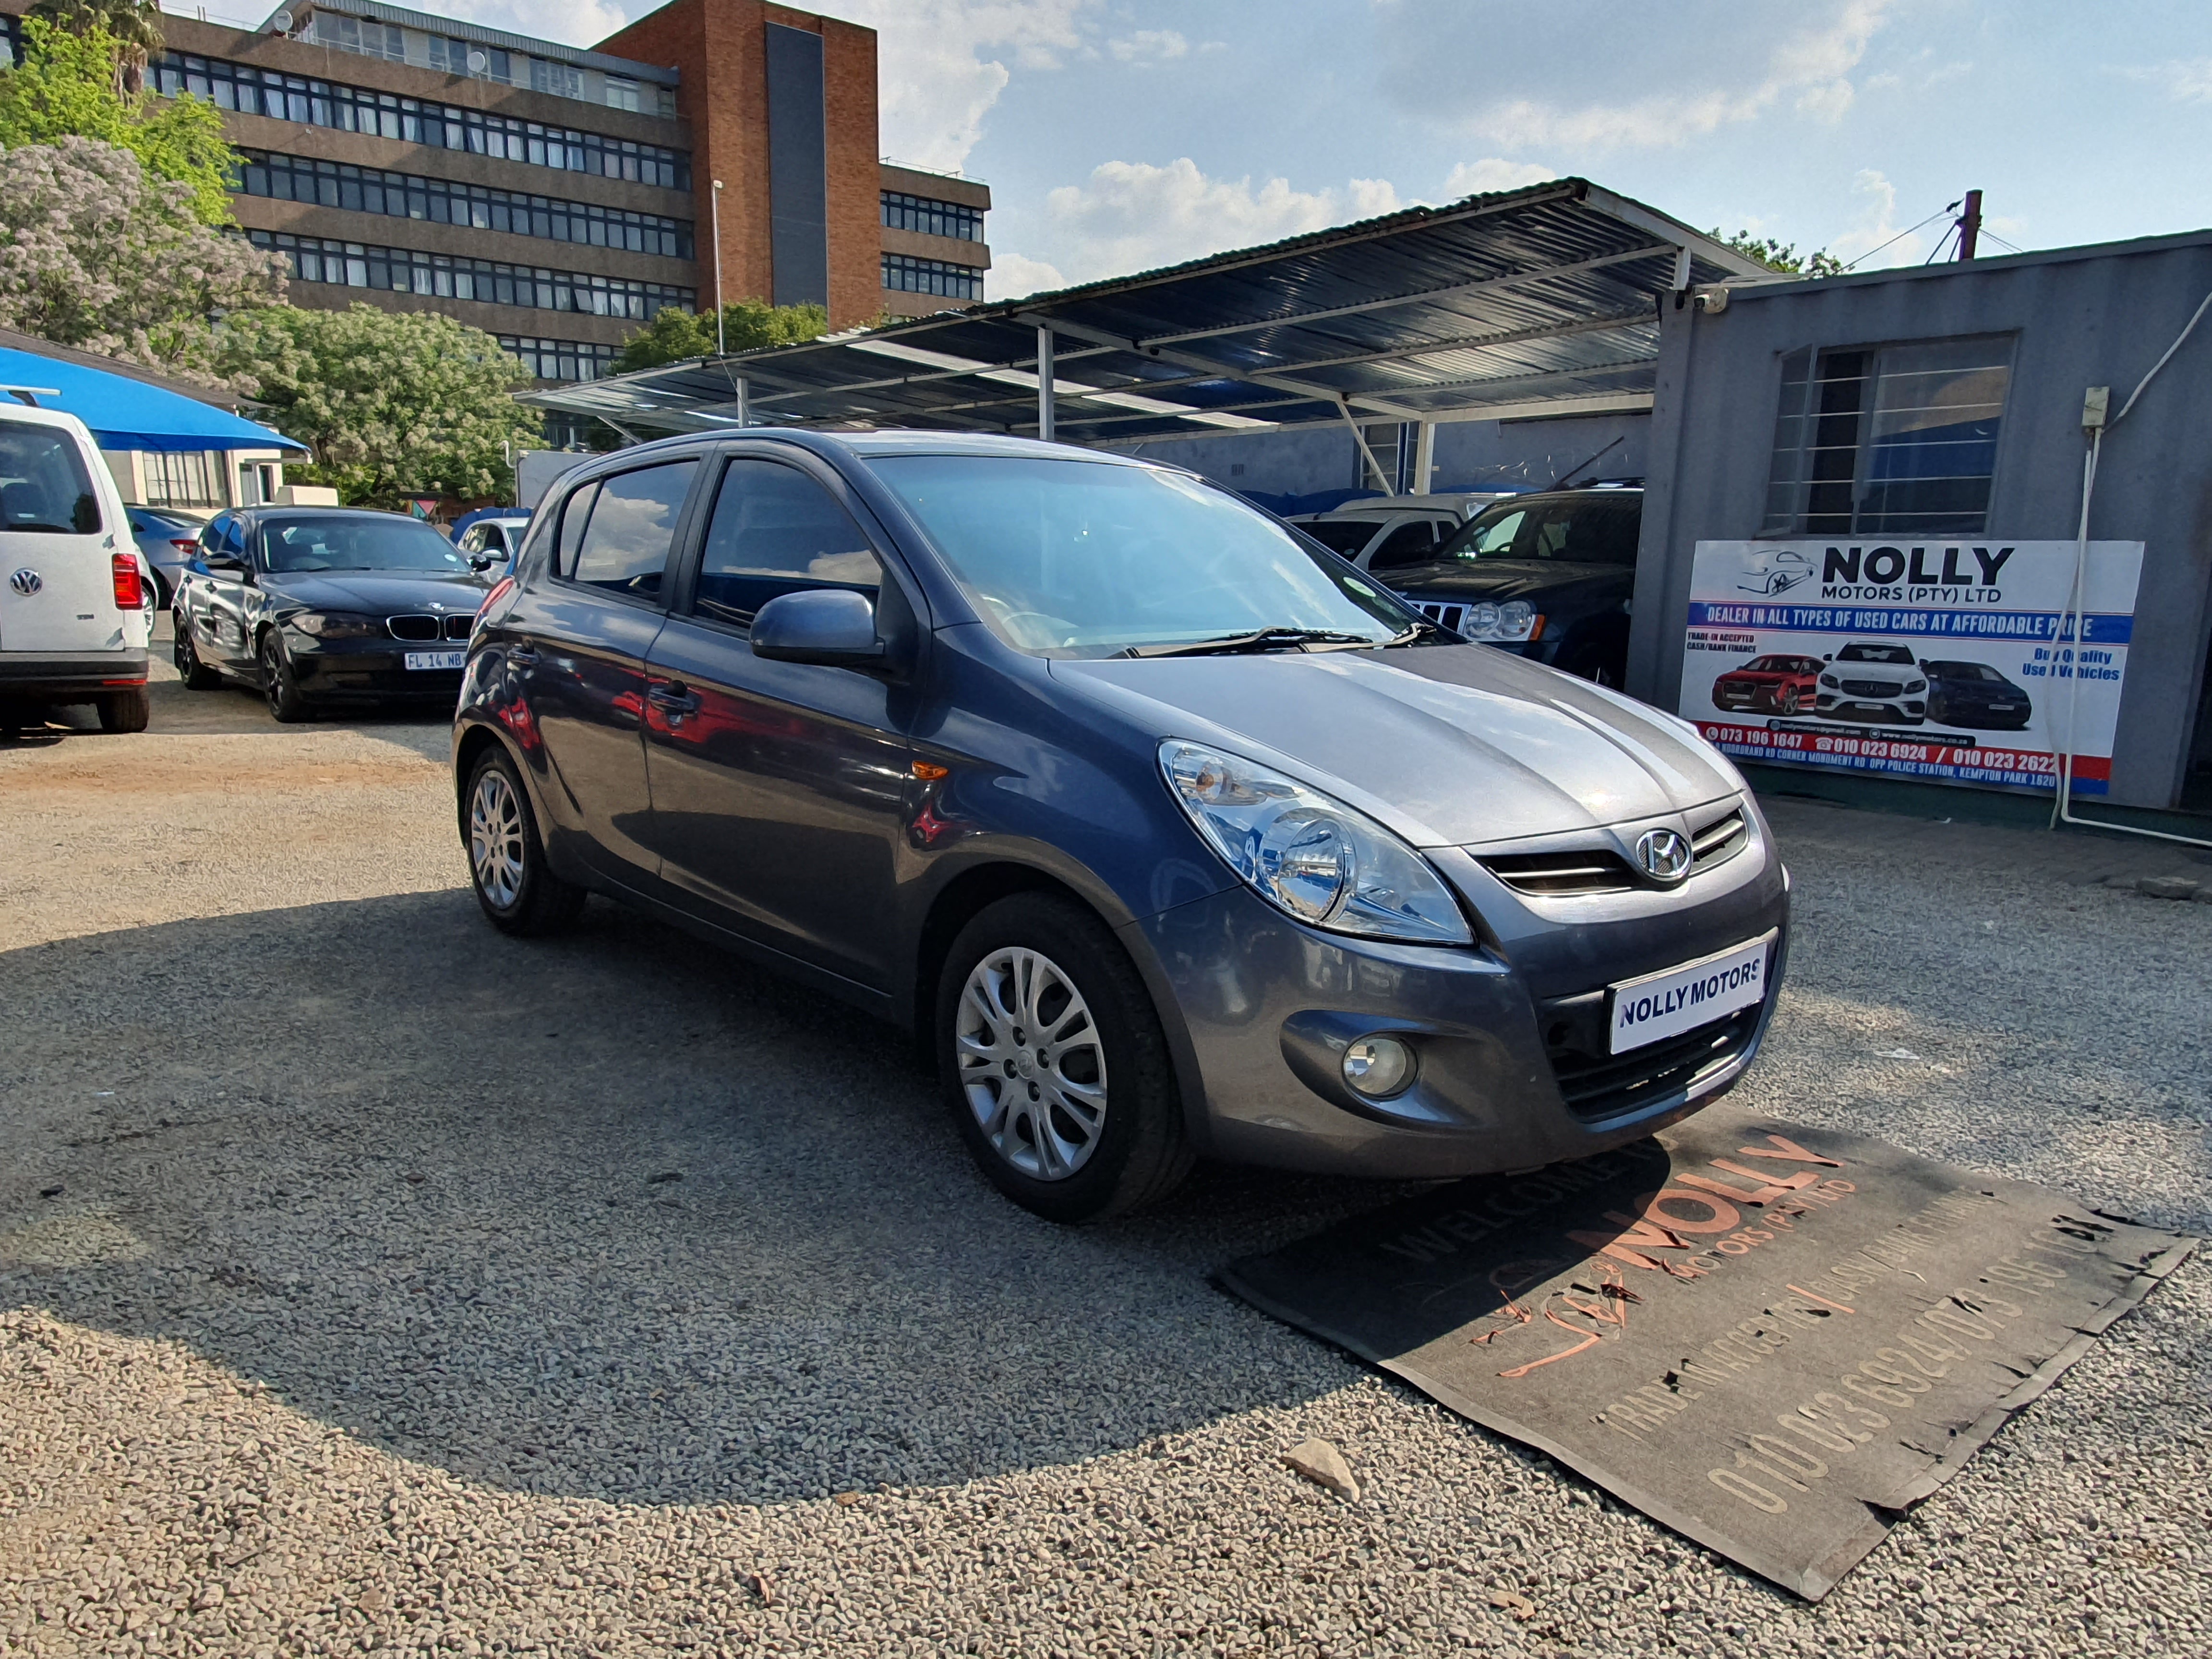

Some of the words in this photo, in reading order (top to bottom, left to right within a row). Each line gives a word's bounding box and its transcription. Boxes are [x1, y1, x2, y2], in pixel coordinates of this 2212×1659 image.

[1822, 547, 2015, 586] NOLLY
[1822, 586, 1902, 601] MOTORS
[1909, 587, 1959, 604] (PTY)
[1965, 589, 2001, 603] LTD
[1707, 606, 1749, 624] DEALER
[1752, 608, 1765, 624] IN
[1767, 608, 1789, 625] ALL
[1793, 609, 1831, 626] TYPES
[1835, 611, 1852, 627] OF
[1855, 611, 1888, 629] USED
[1892, 613, 1927, 630] CARS
[1930, 614, 1949, 631] AT
[1951, 614, 2044, 635] AFFORDABLE
[1719, 634, 1755, 643] ACCEPTED
[408, 654, 422, 667] FL
[447, 653, 462, 666] NB
[1728, 644, 1756, 653] FINANCE
[1720, 727, 1743, 742] 073
[1746, 731, 1769, 745] 196
[1772, 733, 1803, 748] 1647
[1834, 738, 1858, 754] 010
[1861, 741, 1887, 757] 023
[1890, 743, 1927, 760] 6924
[1953, 748, 1981, 765] 010
[1984, 751, 2014, 769] 023
[1766, 747, 1775, 758] RD
[1777, 748, 1806, 761] CORNER
[1808, 752, 1852, 766] MONUMENT
[1854, 757, 1865, 768] RD
[1869, 760, 1886, 770] OPP
[1887, 761, 1916, 773] POLICE
[1918, 763, 1956, 778] STATION,
[1959, 767, 2001, 782] KEMPTON
[2003, 773, 2028, 784] PARK
[2031, 774, 2056, 787] 1620
[1620, 984, 1689, 1028] NOLLY
[1690, 958, 1760, 1006] MOTORS
[1566, 1135, 1845, 1270] NOLLY
[1707, 1433, 1829, 1514] 010
[1777, 1392, 1891, 1453] 023
[1977, 1255, 2068, 1296] 196
